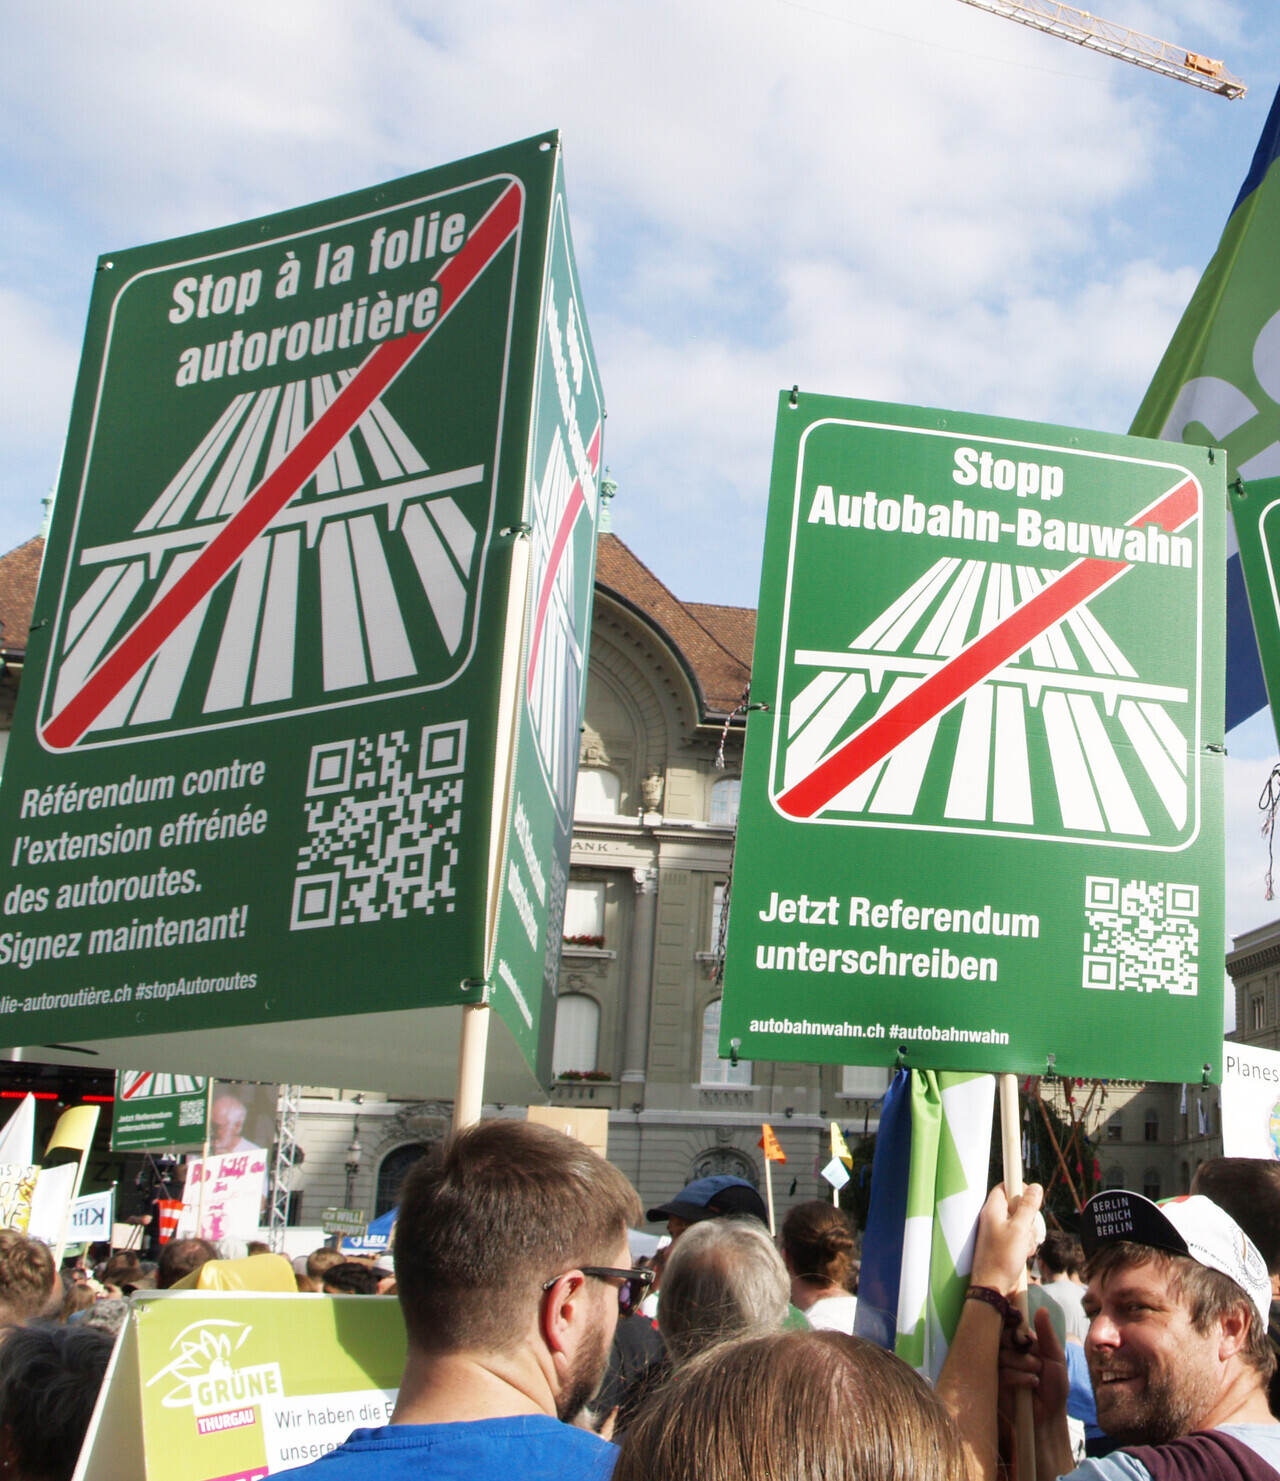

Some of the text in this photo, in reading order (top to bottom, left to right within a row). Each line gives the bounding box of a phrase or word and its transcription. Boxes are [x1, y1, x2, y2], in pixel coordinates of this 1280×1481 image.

[168, 211, 466, 324] Stop à la folie
[175, 286, 439, 388] autoroutière
[952, 446, 1064, 501] Stopp
[807, 485, 1193, 569] Autobahn-Bauwahn
[20, 759, 266, 819] Référendum contre
[11, 804, 268, 867] l’extension effrénée
[571, 840, 608, 852] ANK
[4, 867, 201, 915] des autoroutes.
[758, 892, 1040, 938] Jetzt Referendum
[0, 905, 248, 969] Signez maintenant!
[755, 942, 999, 982] unterschreiben
[0, 967, 257, 1013] lie-autoroutière.ch #stopAutoroutes
[749, 1017, 1010, 1046] autobahnwahn.ch #autobahnwahn
[1226, 1056, 1279, 1082] Planes
[1093, 1197, 1129, 1212] BERLIN
[1095, 1209, 1131, 1224] MUNICH
[1097, 1221, 1133, 1237] BERLIN
[197, 1368, 278, 1406] GRÜNE
[198, 1409, 255, 1433] THURGAU
[275, 1410, 302, 1429] Wir
[307, 1407, 354, 1425] haben
[359, 1404, 381, 1421] die
[280, 1441, 342, 1461] unsere
